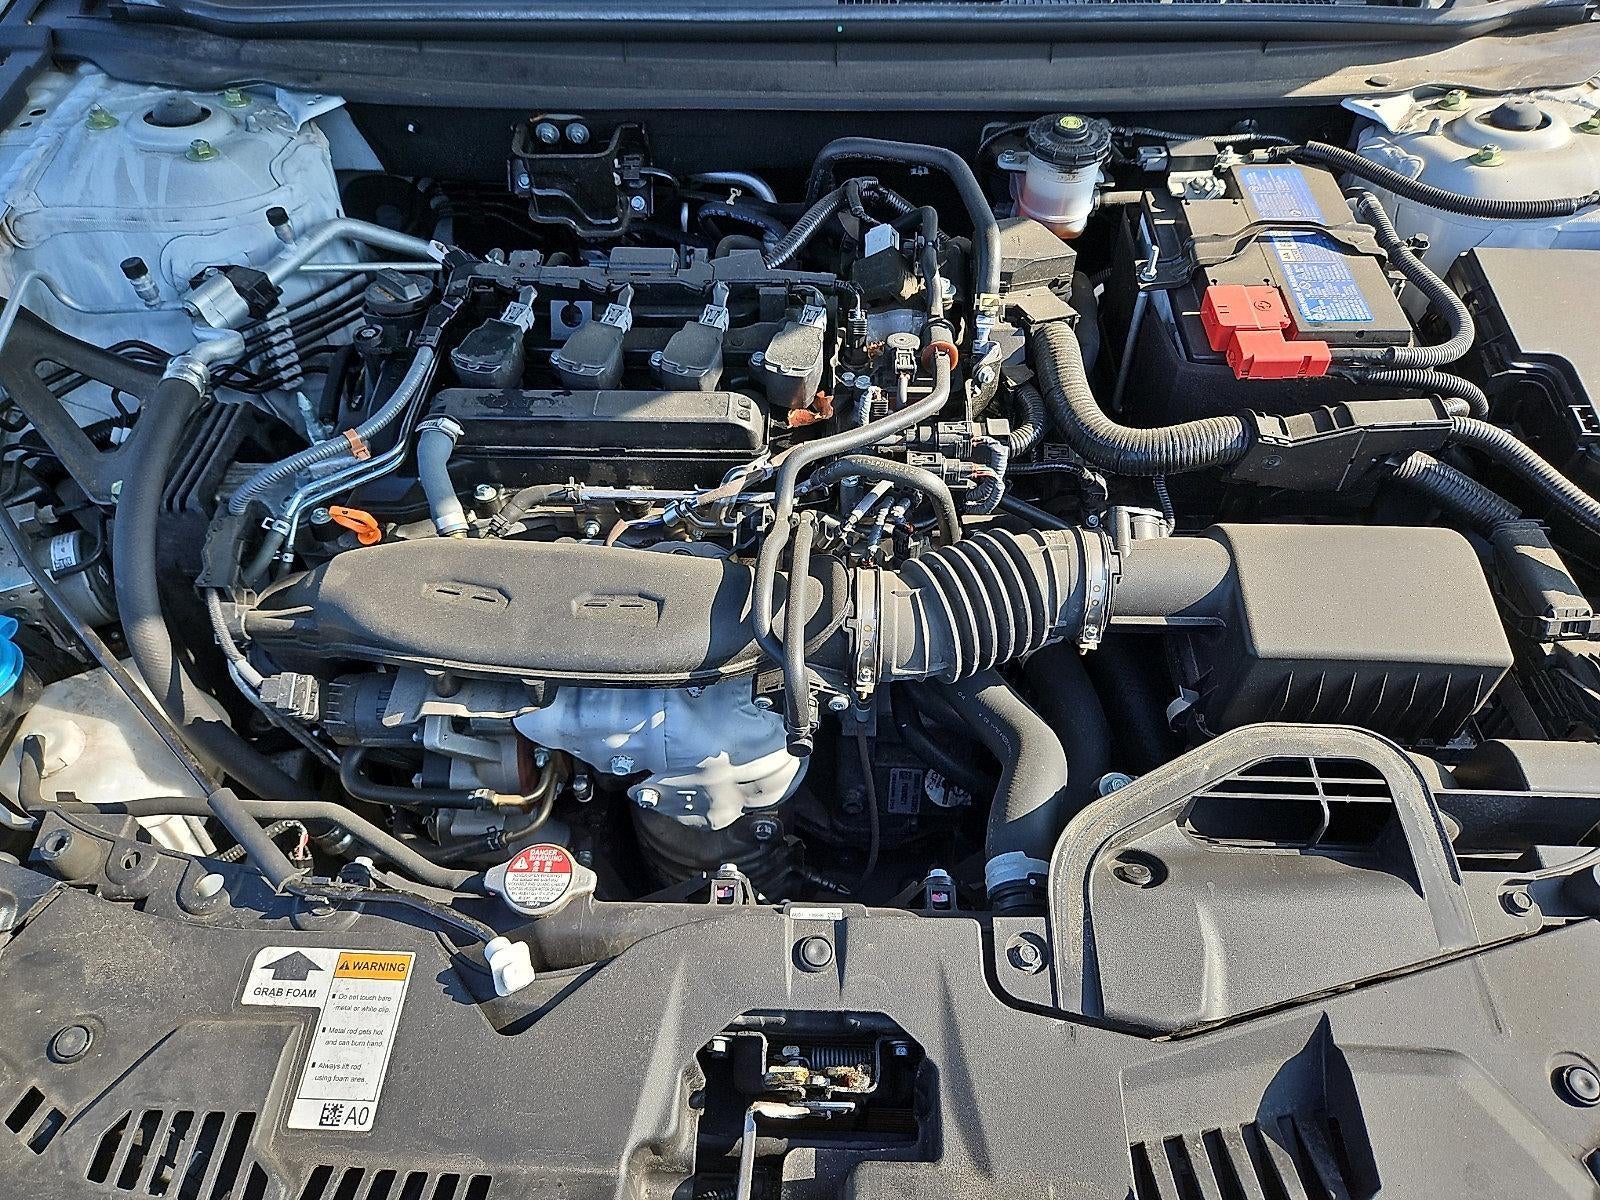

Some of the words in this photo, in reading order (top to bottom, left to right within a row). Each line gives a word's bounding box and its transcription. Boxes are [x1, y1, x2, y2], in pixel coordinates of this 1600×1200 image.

[352, 961, 406, 972] WARNING
[253, 987, 284, 997] GRAB
[286, 988, 317, 998] FOAM
[347, 1027, 359, 1035] rod
[358, 1028, 372, 1036] gets
[373, 1028, 384, 1036] hot
[318, 1062, 341, 1071] Always
[314, 1075, 332, 1083] using
[344, 1106, 370, 1126] A0
